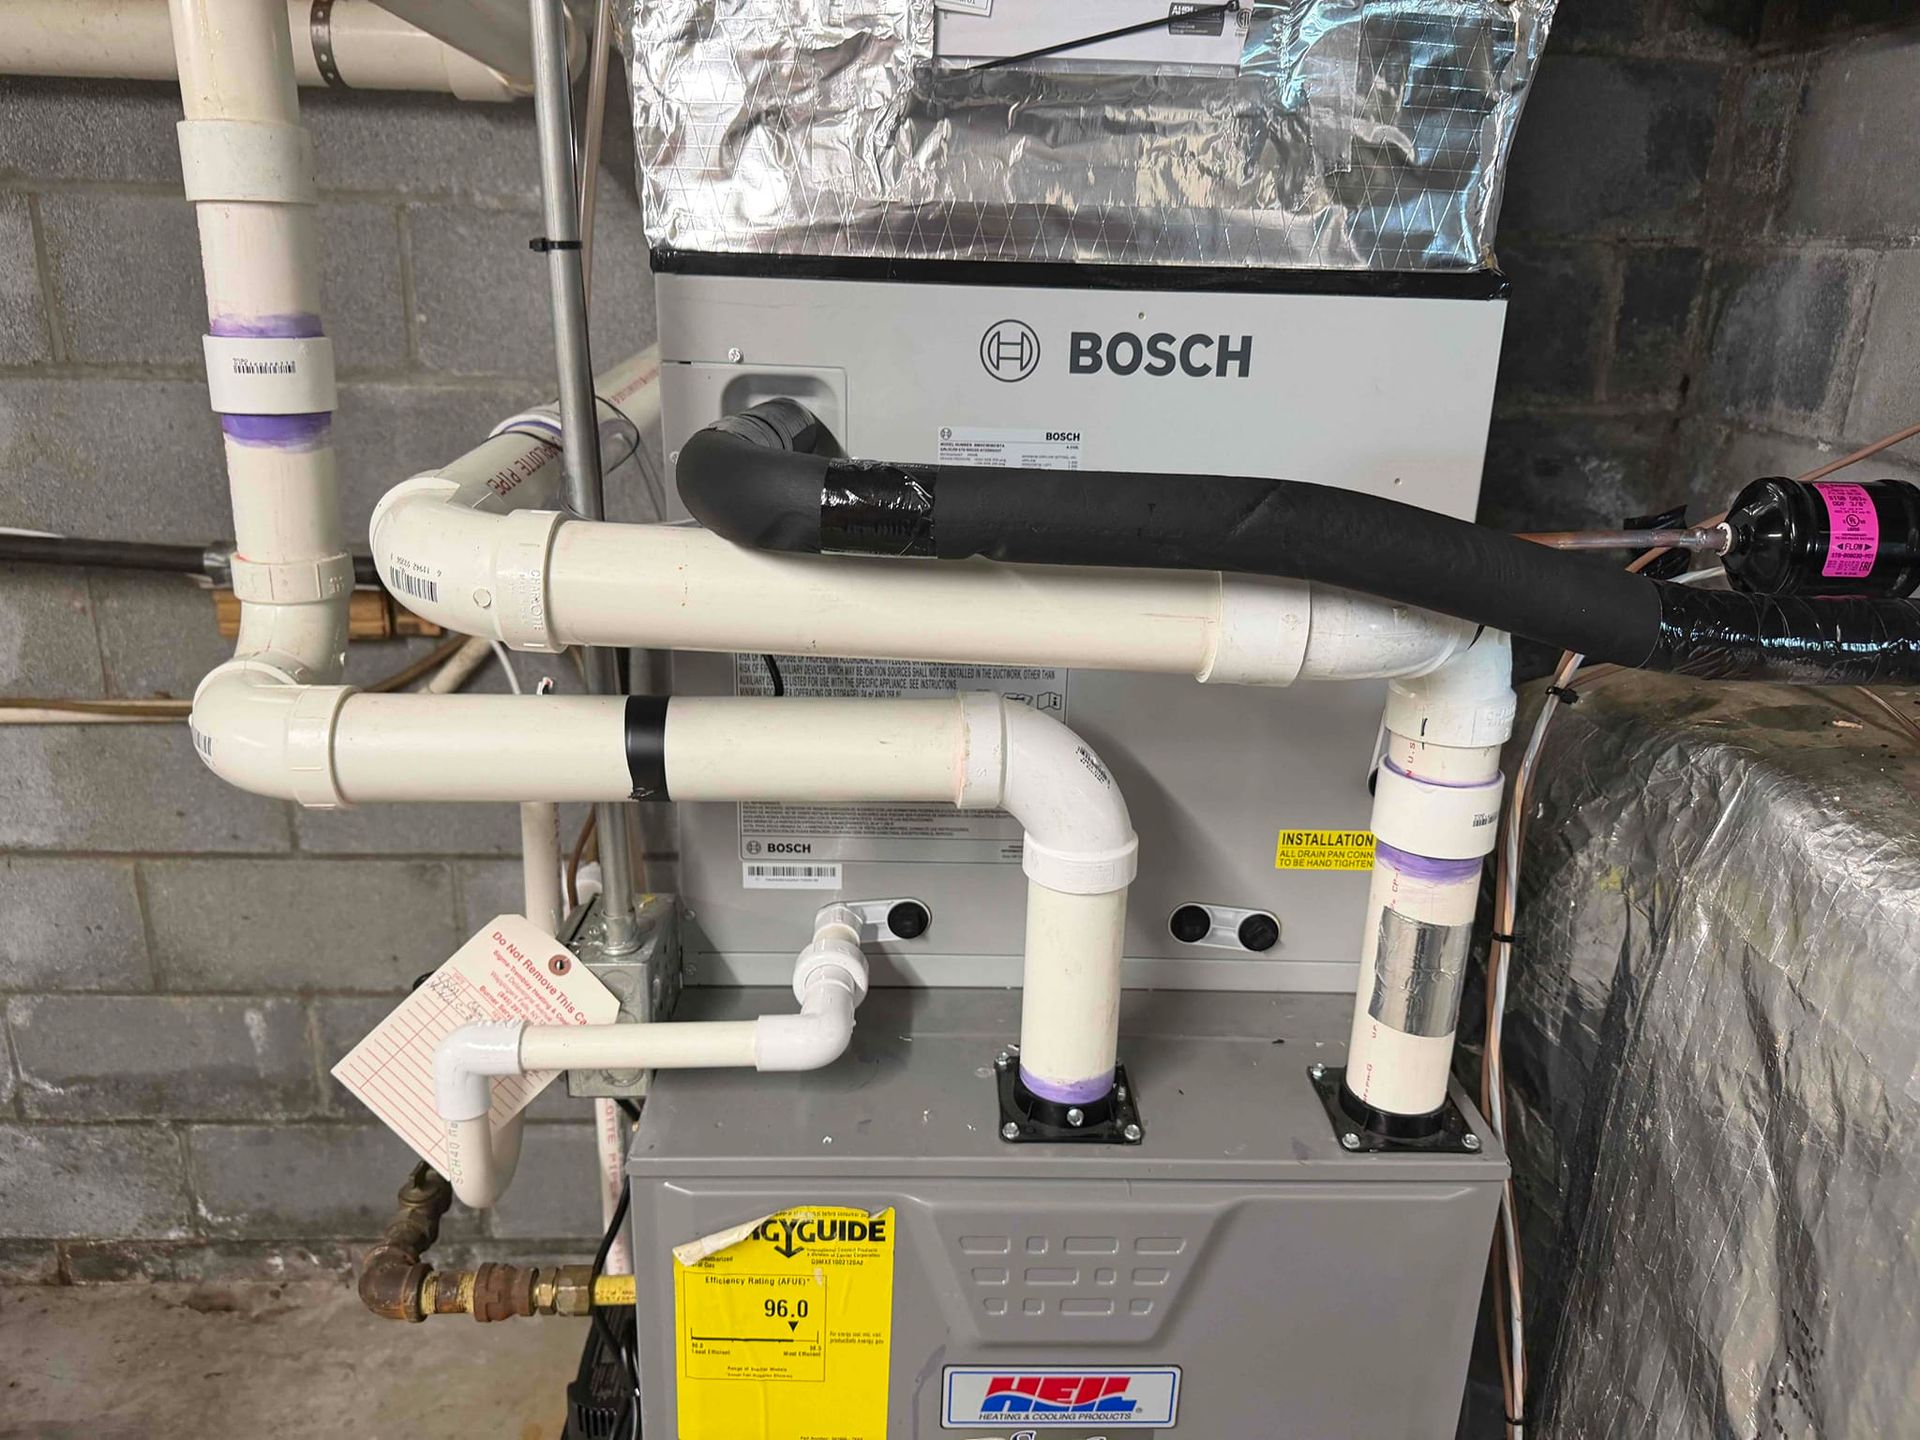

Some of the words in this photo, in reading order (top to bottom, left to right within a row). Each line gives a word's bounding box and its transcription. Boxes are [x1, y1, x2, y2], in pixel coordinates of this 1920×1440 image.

[1069, 331, 1253, 378] BOSCH
[1045, 432, 1080, 441] BOSCH
[493, 467, 523, 496] PIPE
[1844, 542, 1864, 550] FLOW
[912, 668, 927, 677] SHALL
[929, 668, 939, 677] NOT
[941, 668, 947, 678] BE
[948, 668, 974, 678] INSTALLED
[982, 669, 992, 678] THE
[1024, 670, 1041, 680] OTHER
[910, 679, 919, 689] SEE
[1282, 832, 1374, 847] INSTALLATION
[767, 843, 811, 853] BOSCH
[492, 931, 506, 946] Do
[506, 943, 525, 962] Not
[522, 958, 557, 996] Remove
[556, 992, 576, 1014] This
[705, 1276, 745, 1286] Efficiency
[748, 1278, 774, 1286] Rating
[764, 1300, 808, 1318] 96.0
[980, 1377, 1137, 1412] HEIL
